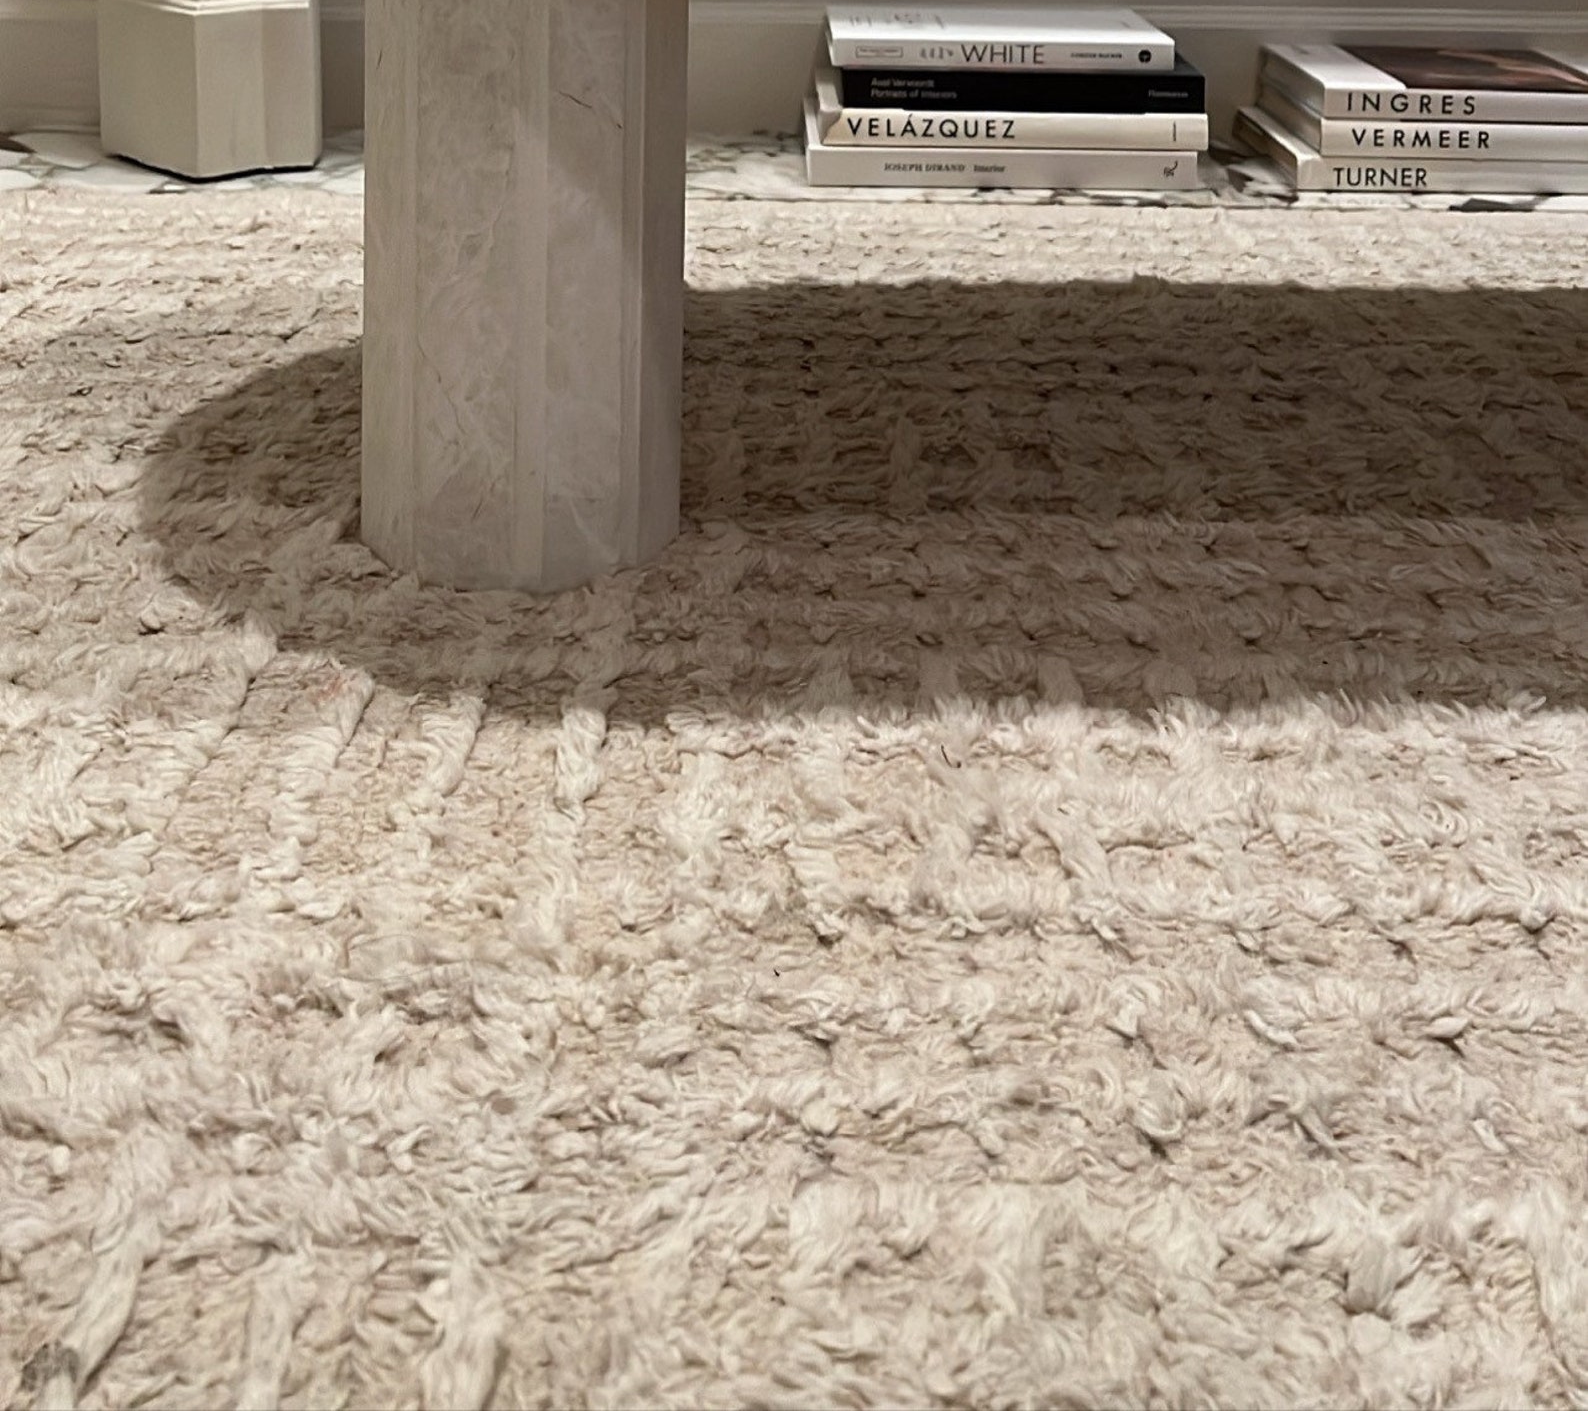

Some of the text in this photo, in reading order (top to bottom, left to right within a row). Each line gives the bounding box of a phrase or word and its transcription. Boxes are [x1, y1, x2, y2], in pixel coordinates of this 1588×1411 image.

[961, 44, 1045, 65] WHITE
[1347, 92, 1477, 116] INGRES
[847, 114, 1016, 139] VELÁZQUEZ
[1351, 128, 1491, 149] VERMEER
[1333, 167, 1428, 187] TURNER
